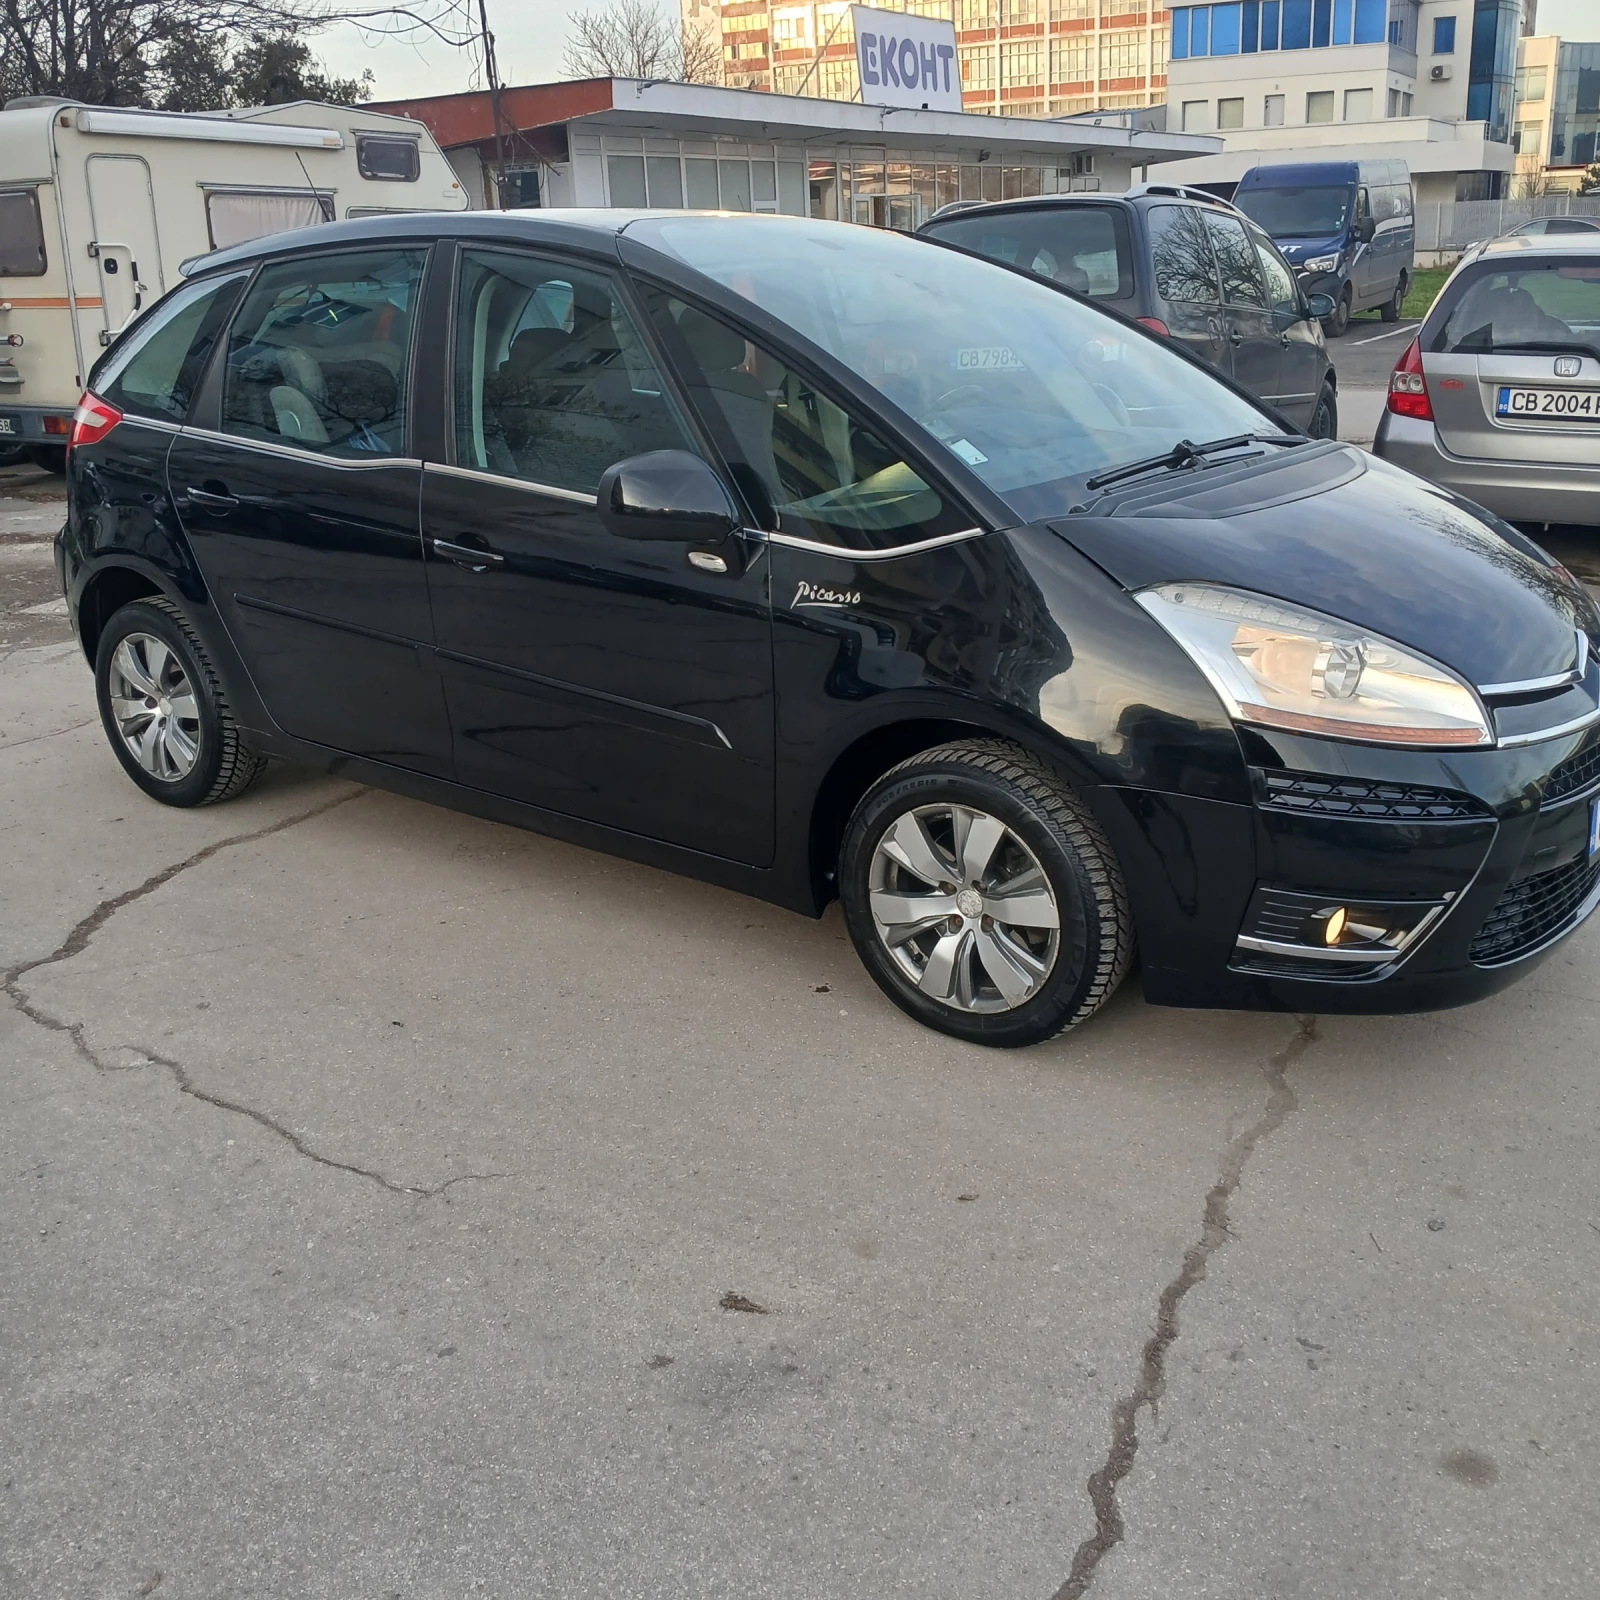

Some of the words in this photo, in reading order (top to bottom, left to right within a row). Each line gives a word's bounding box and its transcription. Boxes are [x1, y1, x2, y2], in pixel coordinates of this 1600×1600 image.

[861, 32, 954, 93] ЕКОНТ
[1512, 392, 1538, 411] CB
[1542, 394, 1592, 414] 2004
[790, 580, 861, 609] Picasso
